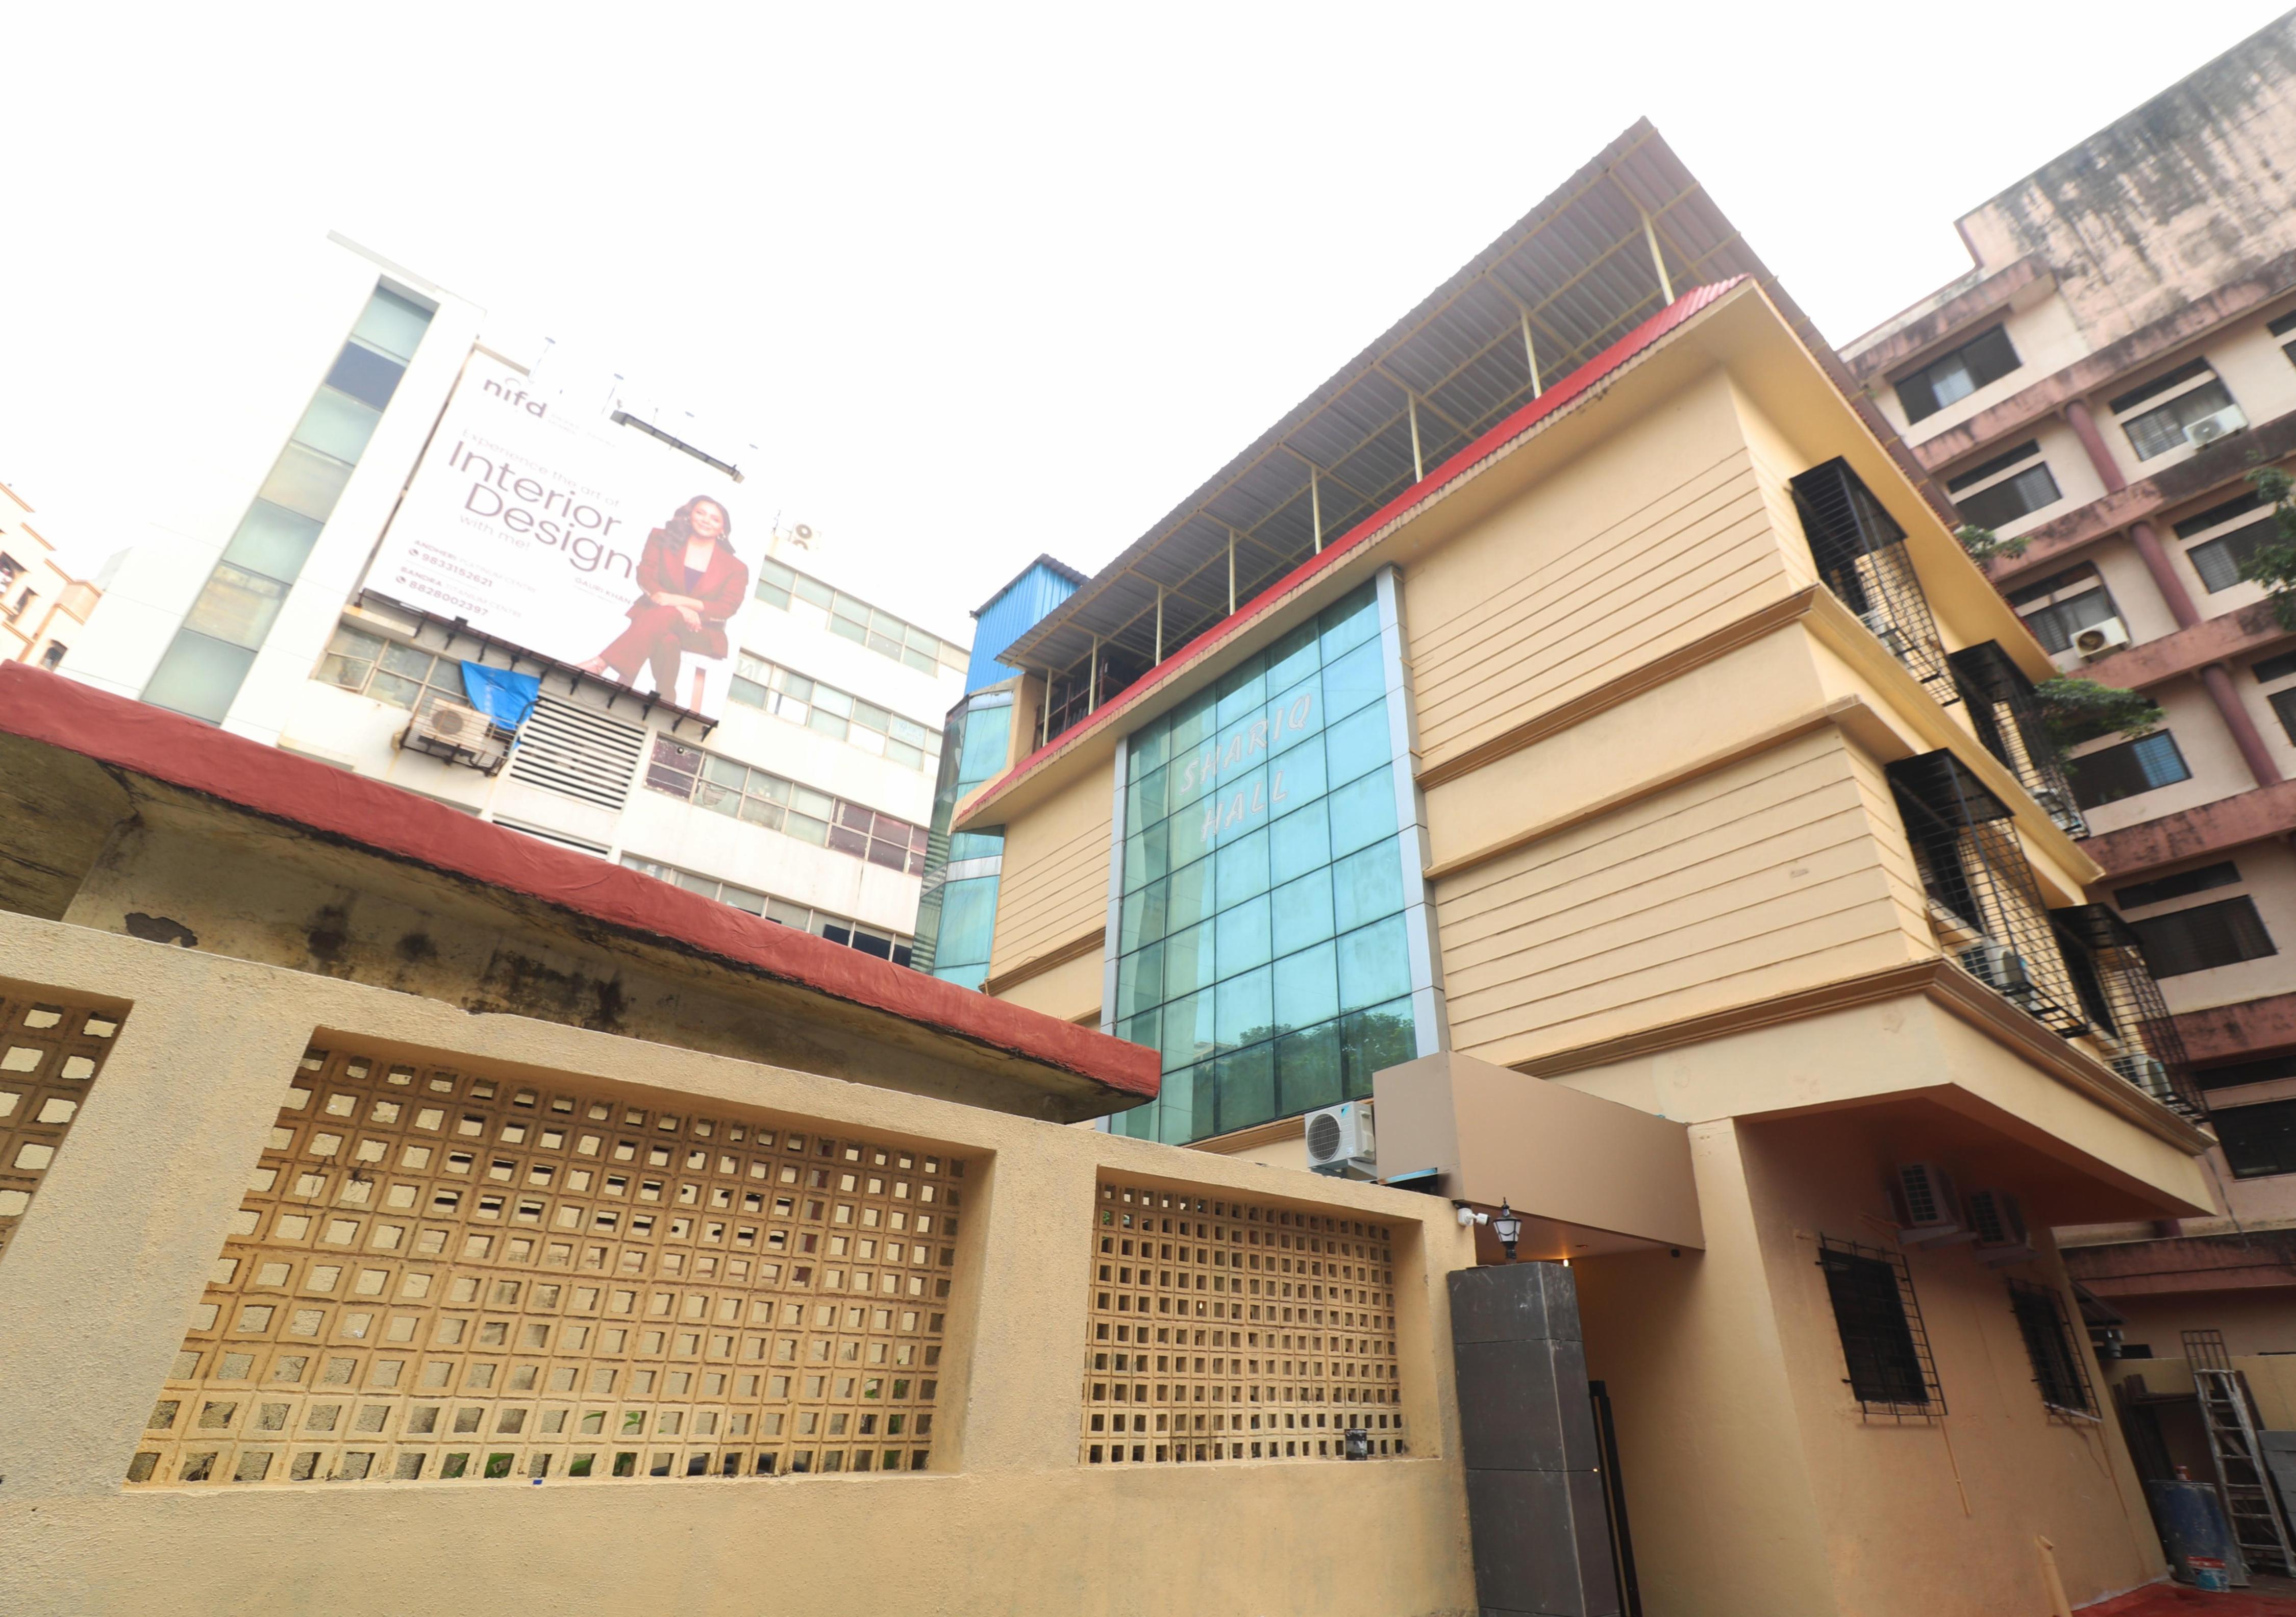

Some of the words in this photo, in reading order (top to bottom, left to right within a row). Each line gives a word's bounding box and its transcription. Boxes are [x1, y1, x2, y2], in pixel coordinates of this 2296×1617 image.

[483, 378, 548, 418] nifd
[462, 428, 548, 475] Experience
[552, 470, 577, 488] the
[581, 485, 602, 500] art
[605, 496, 621, 508] of
[448, 440, 622, 537] Interior
[414, 539, 458, 561] ANDHERI
[459, 513, 494, 535] with
[497, 531, 531, 552] me!
[463, 482, 634, 580] Design
[400, 565, 443, 587] BANDRA
[421, 552, 494, 588] 9833152621
[408, 580, 489, 616] 8828002397
[575, 577, 604, 593] GAURI
[605, 590, 632, 605] KHAN
[1178, 693, 1313, 796] SHARIQ
[1200, 769, 1289, 842] HALL
